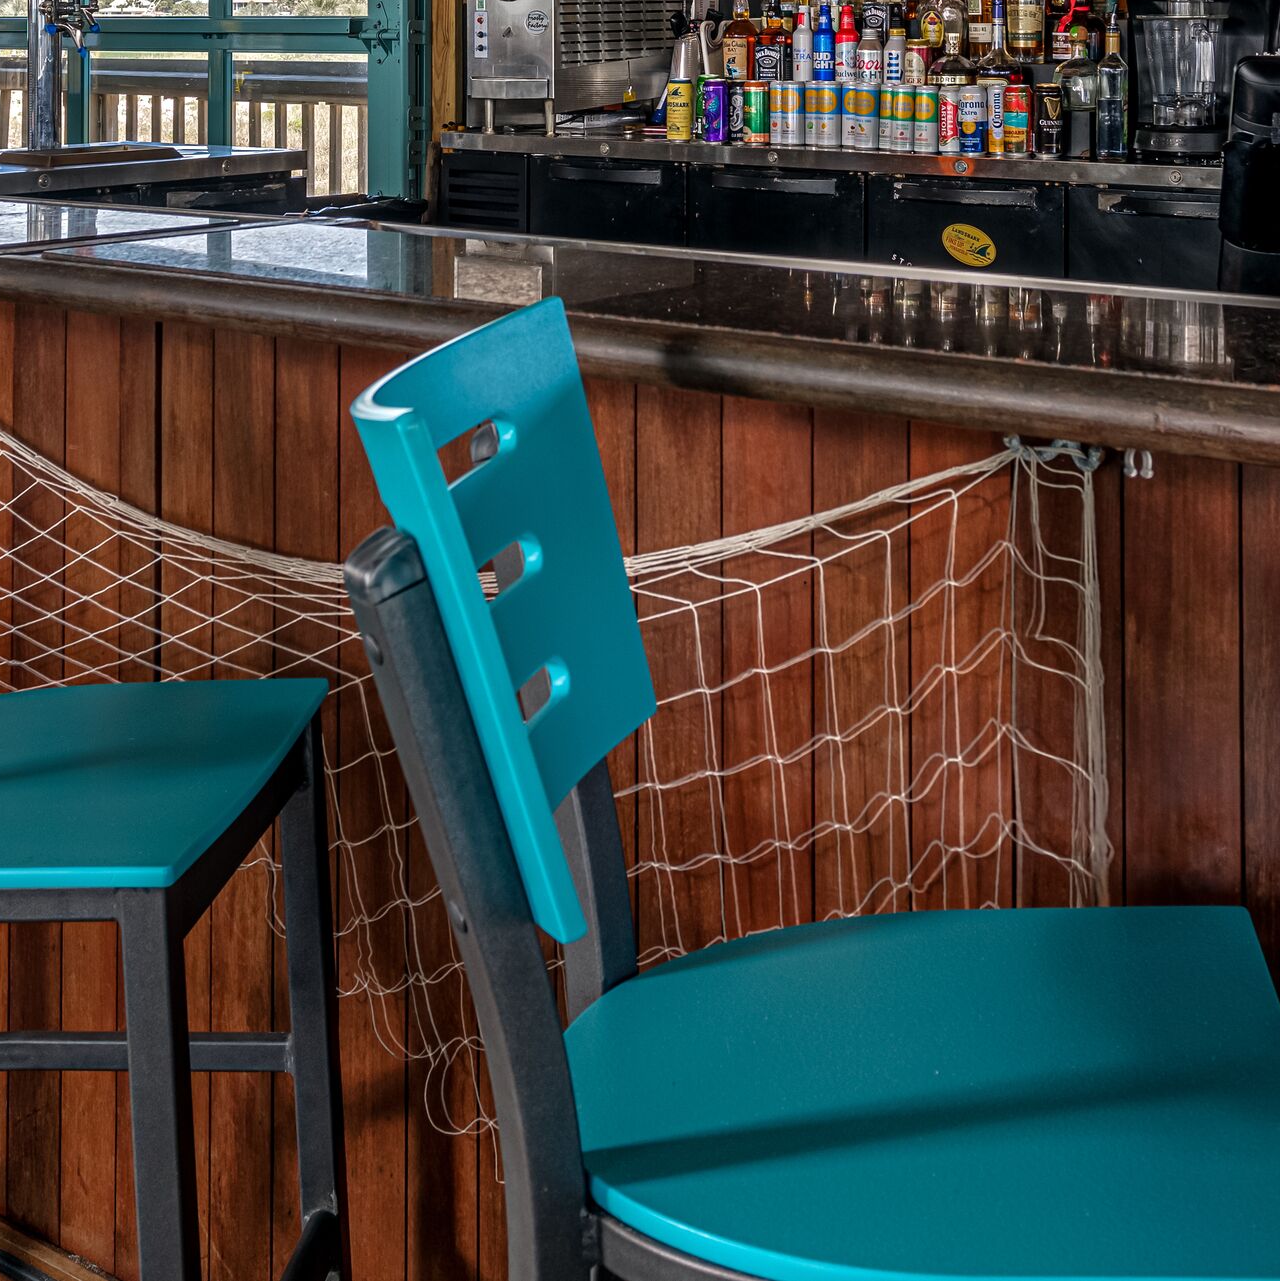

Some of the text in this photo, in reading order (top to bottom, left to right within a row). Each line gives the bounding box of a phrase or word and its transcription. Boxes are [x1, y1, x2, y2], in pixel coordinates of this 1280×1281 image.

[527, 14, 545, 23] Frosty
[527, 20, 548, 30] Factory
[814, 61, 835, 70] GHT
[960, 99, 985, 109] Corona
[992, 92, 1003, 129] Corona
[946, 105, 954, 136] STELLA
[951, 226, 980, 242] LANDSHARK
[945, 236, 965, 248] FINS UP
